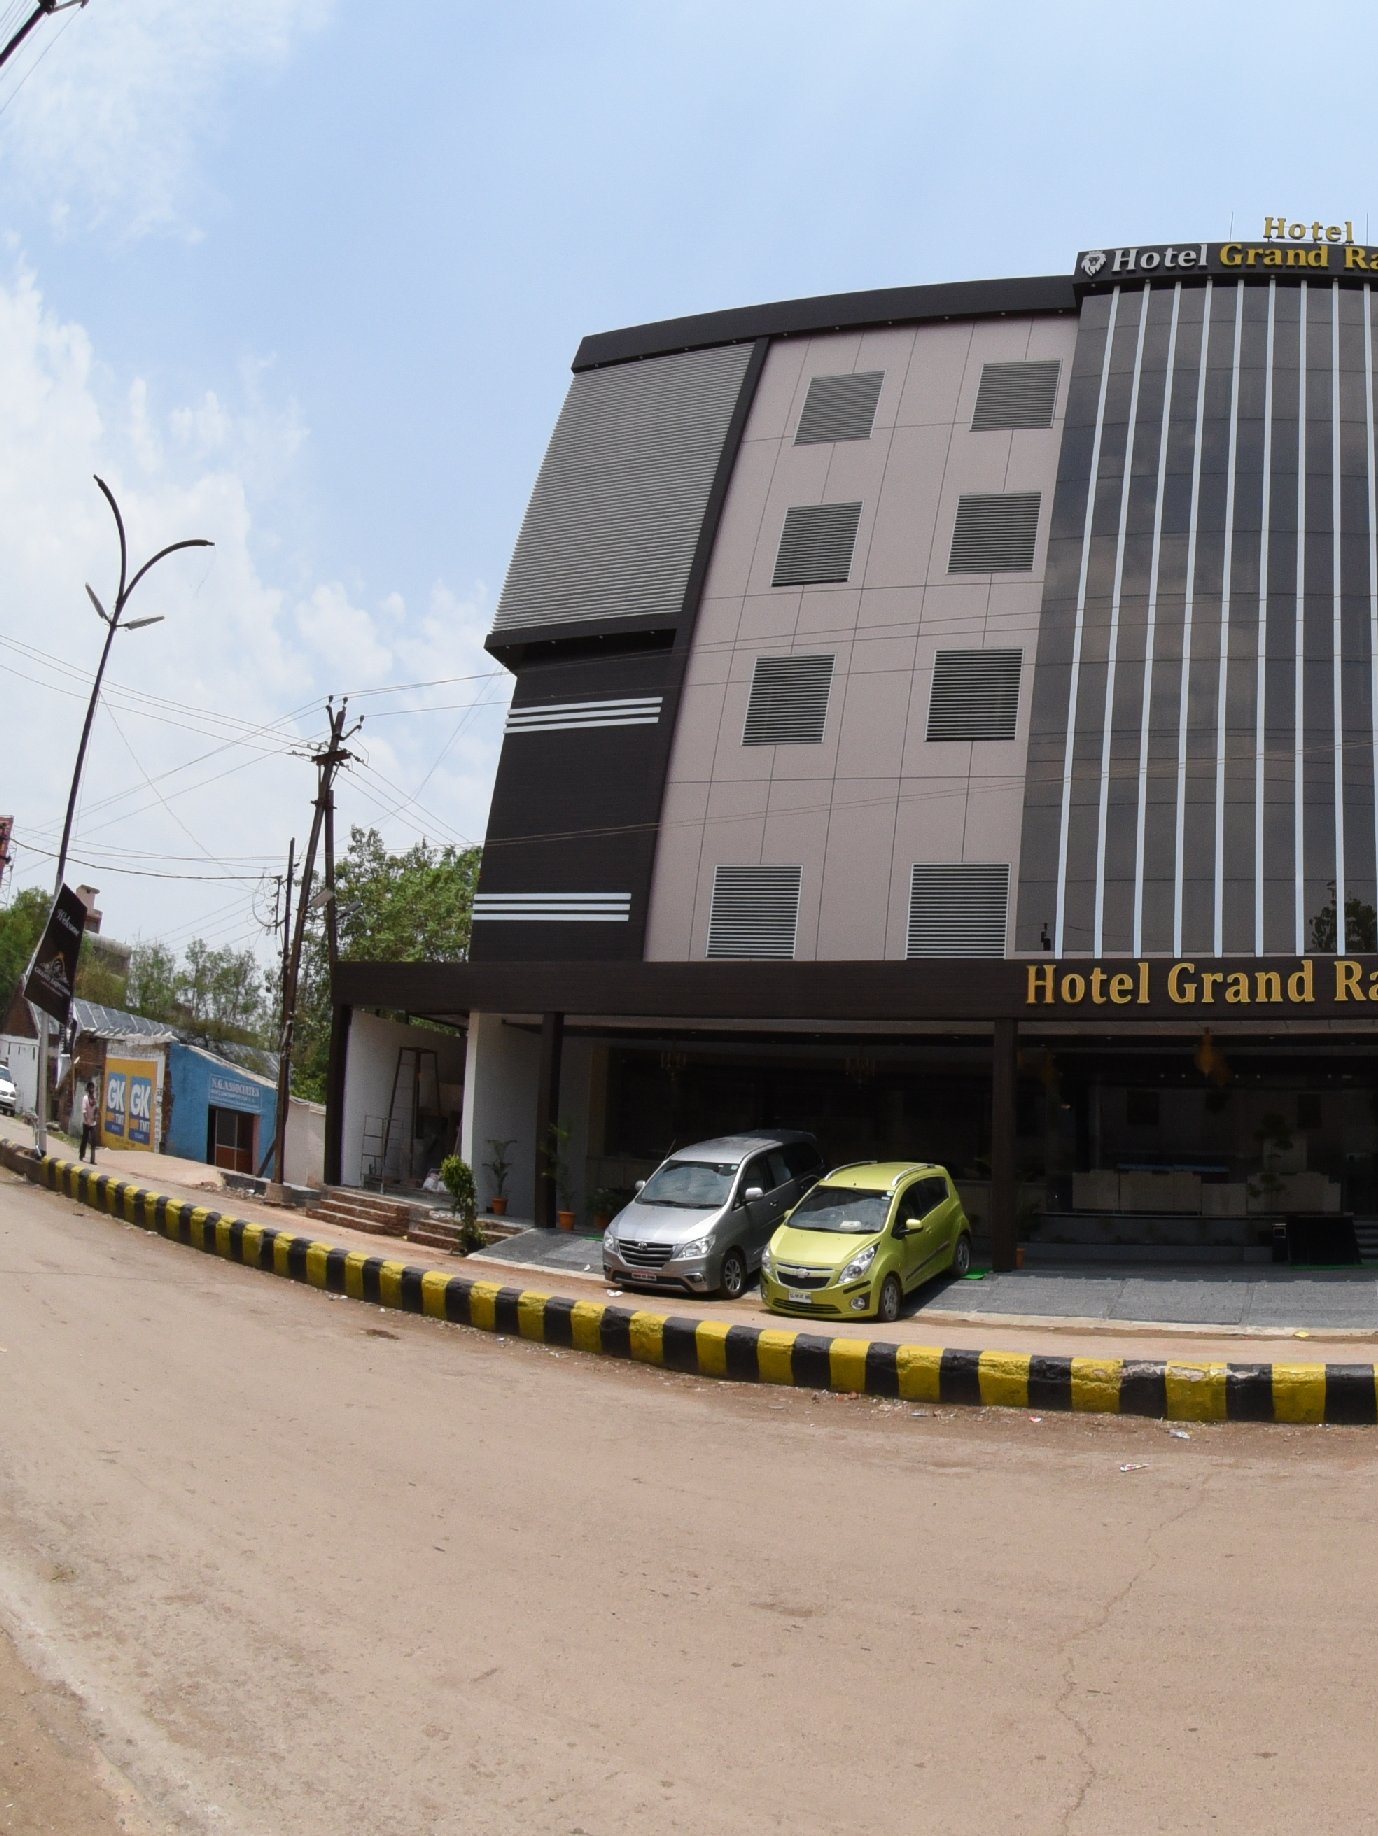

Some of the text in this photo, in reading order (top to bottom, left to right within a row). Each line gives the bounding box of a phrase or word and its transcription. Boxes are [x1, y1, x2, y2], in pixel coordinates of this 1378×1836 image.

[1263, 216, 1354, 244] Hotel
[1112, 243, 1208, 272] Hotel
[1220, 243, 1329, 268] Grand
[1025, 962, 1151, 1004] Hotel
[1167, 959, 1315, 1004] Grand
[107, 1078, 126, 1112] GK
[130, 1083, 151, 1119] GK
